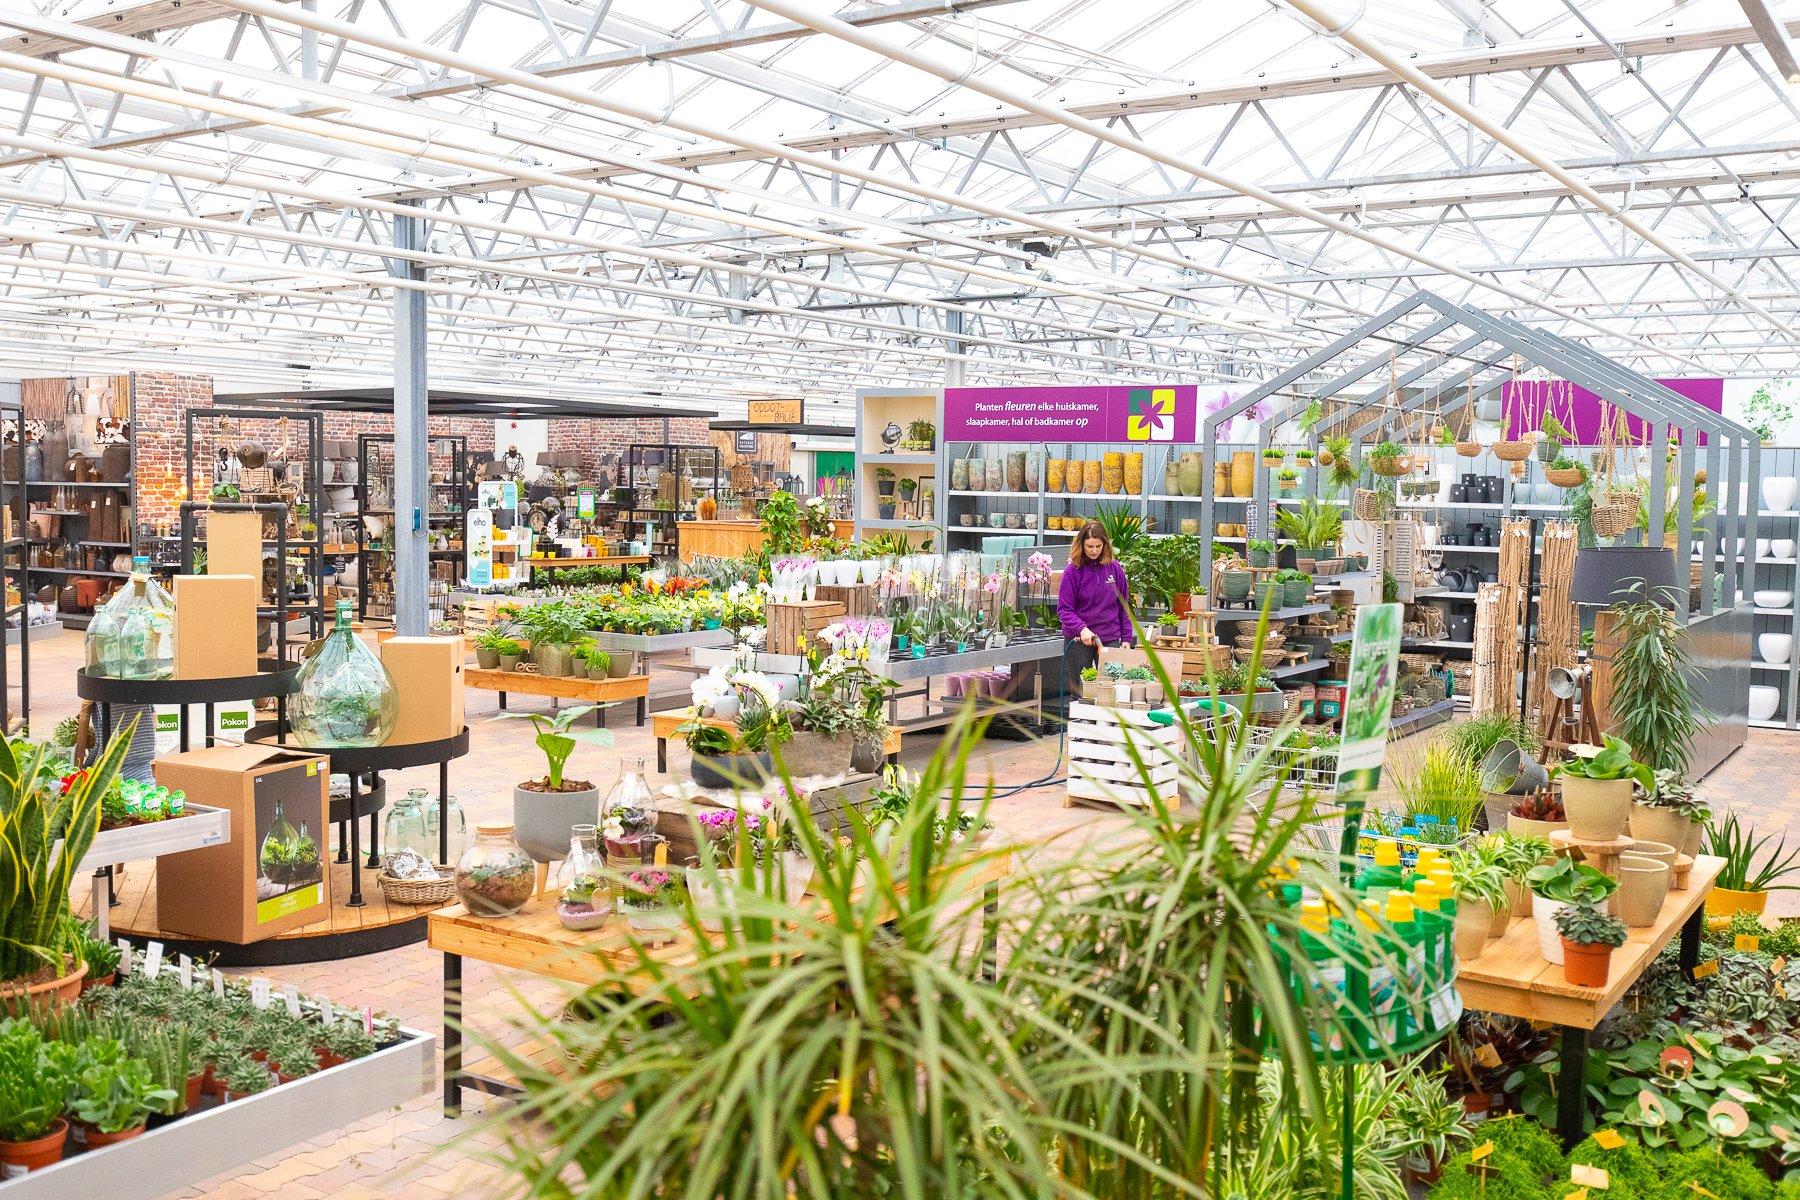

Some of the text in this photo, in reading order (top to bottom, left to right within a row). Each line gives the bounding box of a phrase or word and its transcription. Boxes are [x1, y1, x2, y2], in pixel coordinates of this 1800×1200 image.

[975, 401, 1099, 412] Planten fleuren elke huiskamer,
[774, 413, 796, 422] BALIE
[966, 417, 1088, 428] slaapkamer, hal of badkamer op
[473, 517, 486, 527] elho
[157, 721, 177, 729] okon
[221, 718, 247, 726] Pokon
